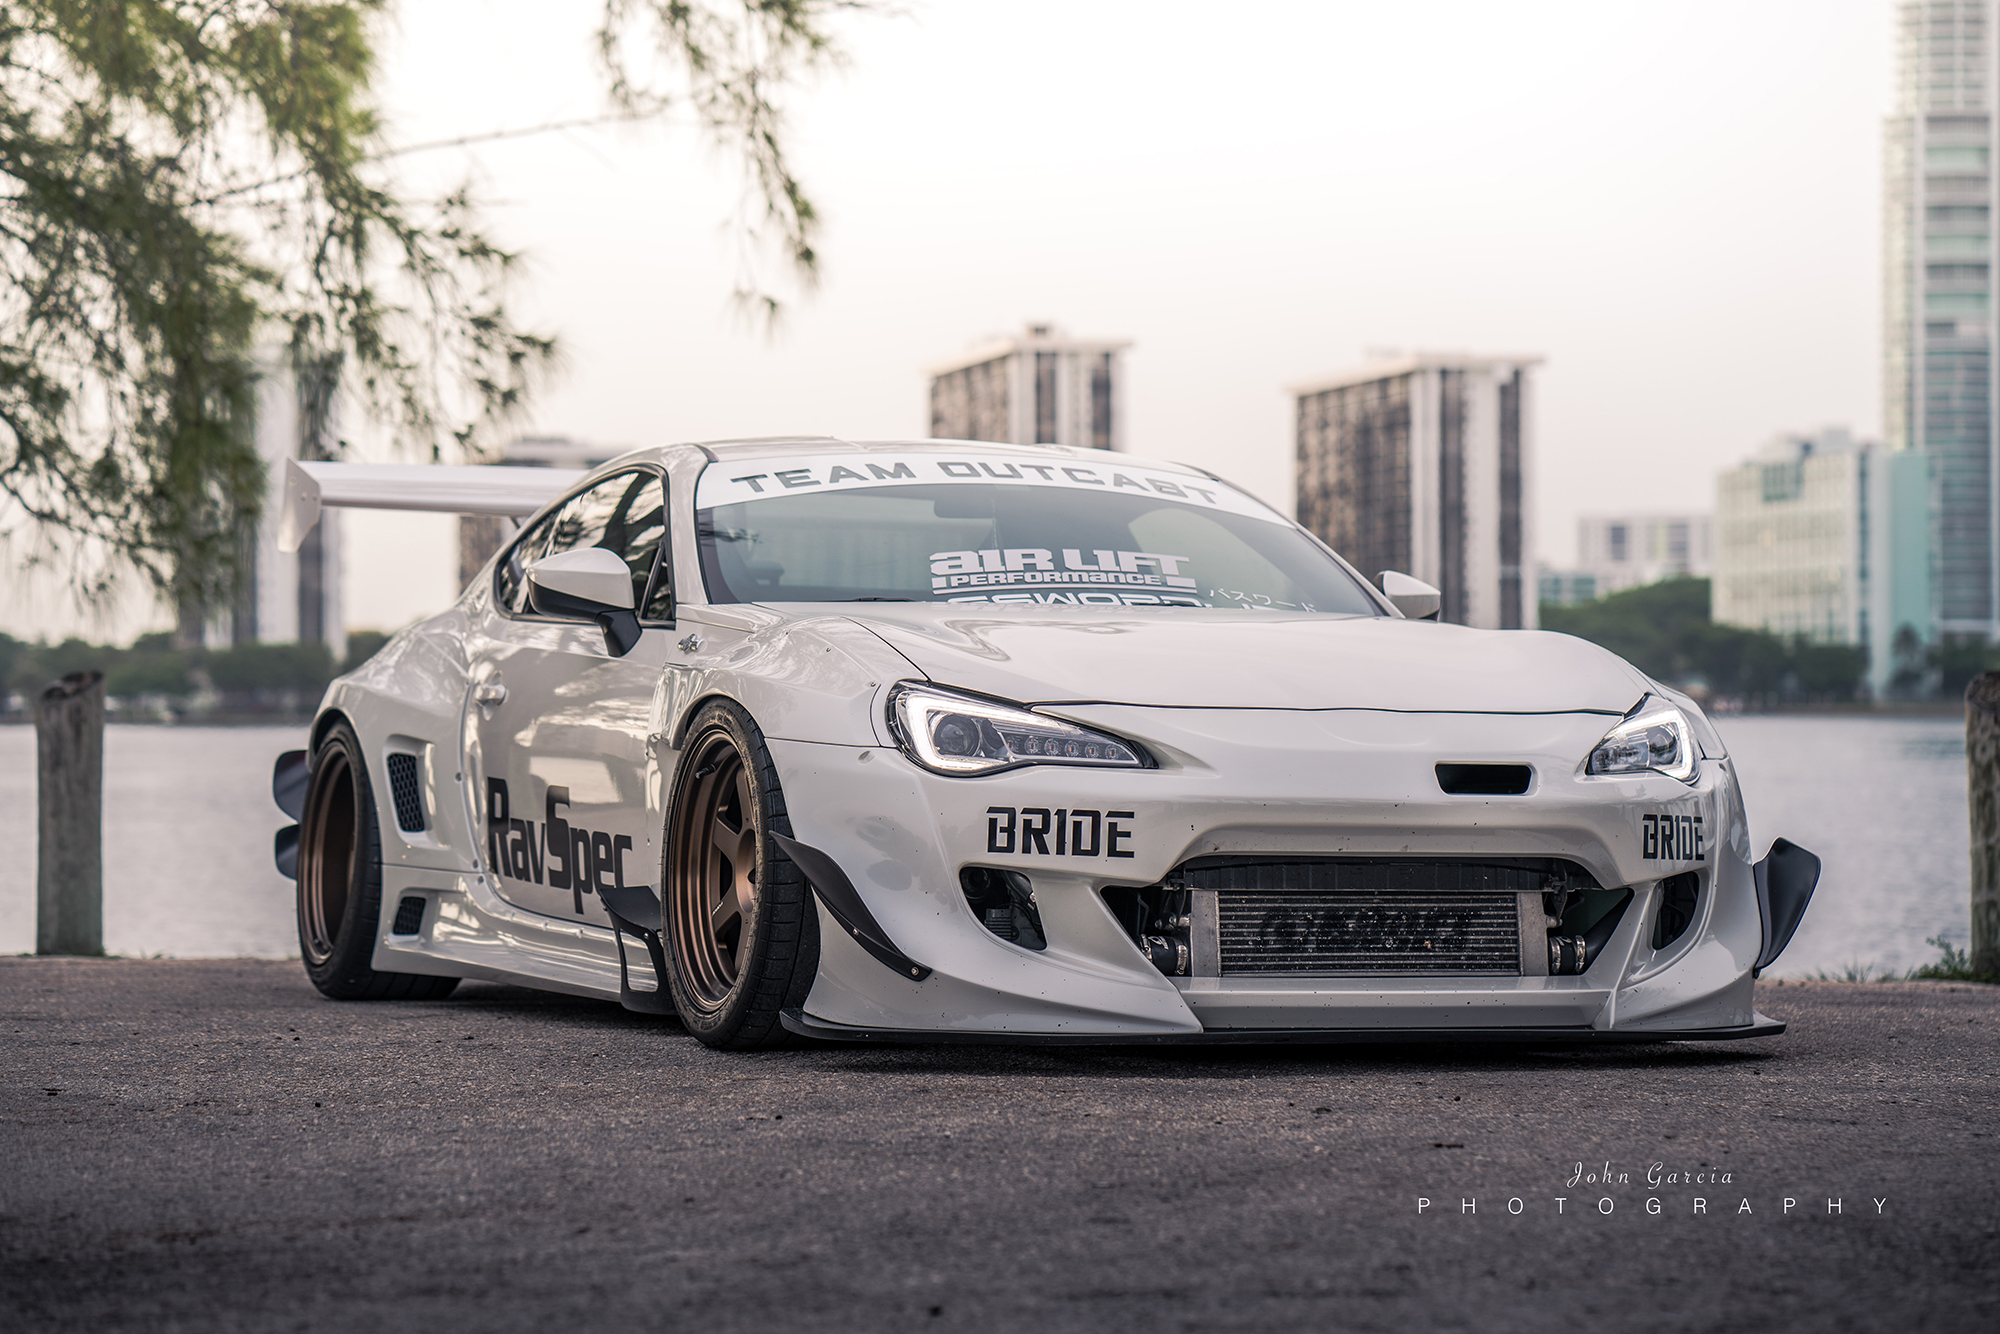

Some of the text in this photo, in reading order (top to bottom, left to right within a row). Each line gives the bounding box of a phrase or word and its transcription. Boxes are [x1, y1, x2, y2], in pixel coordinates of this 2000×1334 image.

[730, 460, 1218, 505] TEAM OUTCAST
[1061, 548, 1190, 576] LIFT
[487, 776, 632, 916] RavSpec
[986, 806, 1136, 859] BRIDE
[1642, 813, 1706, 861] BRIDE
